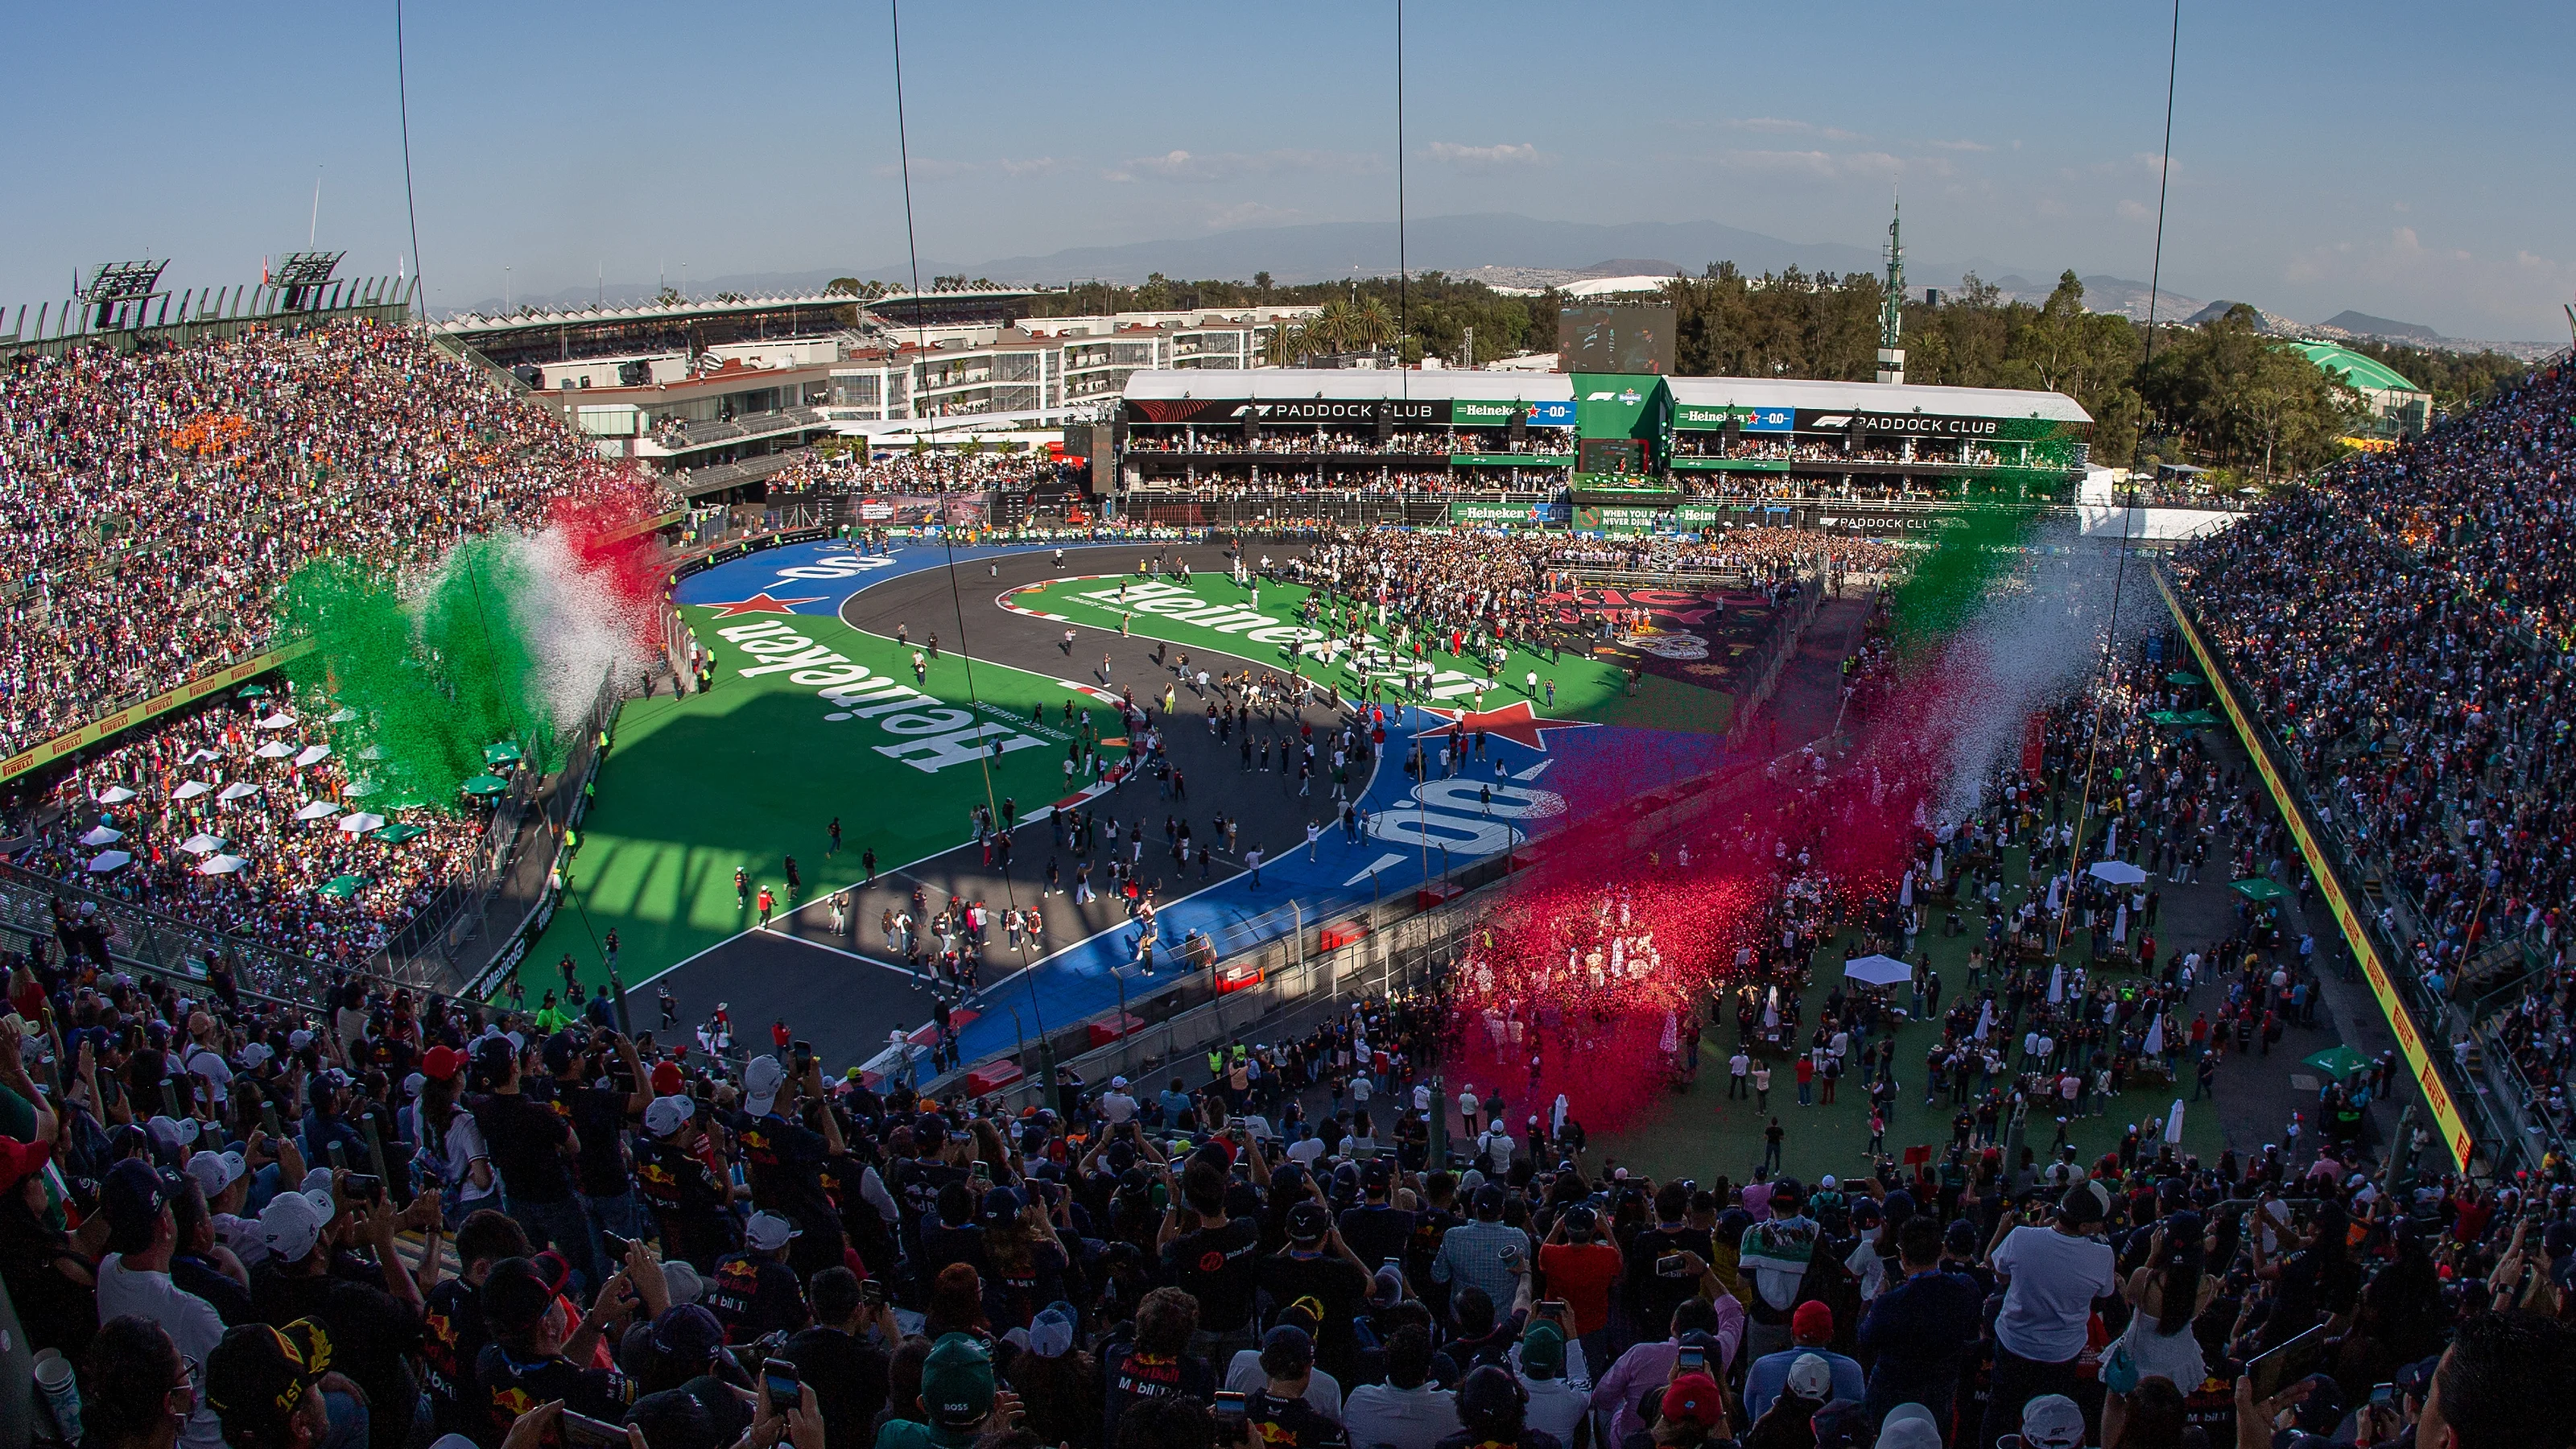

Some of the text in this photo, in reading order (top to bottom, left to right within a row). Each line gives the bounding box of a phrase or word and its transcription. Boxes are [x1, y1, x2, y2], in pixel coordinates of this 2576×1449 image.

[1587, 392, 1616, 401] F1
[1277, 405, 1372, 417] PADDOCK
[1393, 405, 1432, 417] LUB
[1466, 405, 1565, 418] Heineke 0.0
[1768, 413, 1784, 424] 0.0
[1811, 415, 1852, 427] F1
[1950, 420, 1996, 434] CLUB
[1467, 507, 1525, 519] Heineken
[1603, 510, 1629, 518] WHEN
[1630, 510, 1648, 518] YOU
[1603, 518, 1630, 526] NEVER
[1684, 510, 1716, 521] Heine
[1840, 518, 1902, 528] PADDOCK
[231, 663, 256, 681] PIRELLI
[189, 678, 216, 698] PIRELLI
[716, 620, 1051, 773] Heineken
[146, 696, 173, 716] PIRELLI
[100, 713, 130, 735] PIRELLI
[52, 733, 83, 755] PIRELLI
[2, 753, 35, 778] PIRELLI
[1358, 778, 1567, 855] 0.0
[479, 937, 526, 1001] #MexicoGP
[2367, 954, 2385, 998] PIRELLI
[2392, 1004, 2413, 1054] PIRELLI
[2422, 1059, 2446, 1119] PIRELLI
[275, 1378, 303, 1411] 1ST
[1119, 1377, 1154, 1397] Mobil
[943, 1402, 969, 1411] BOSS
